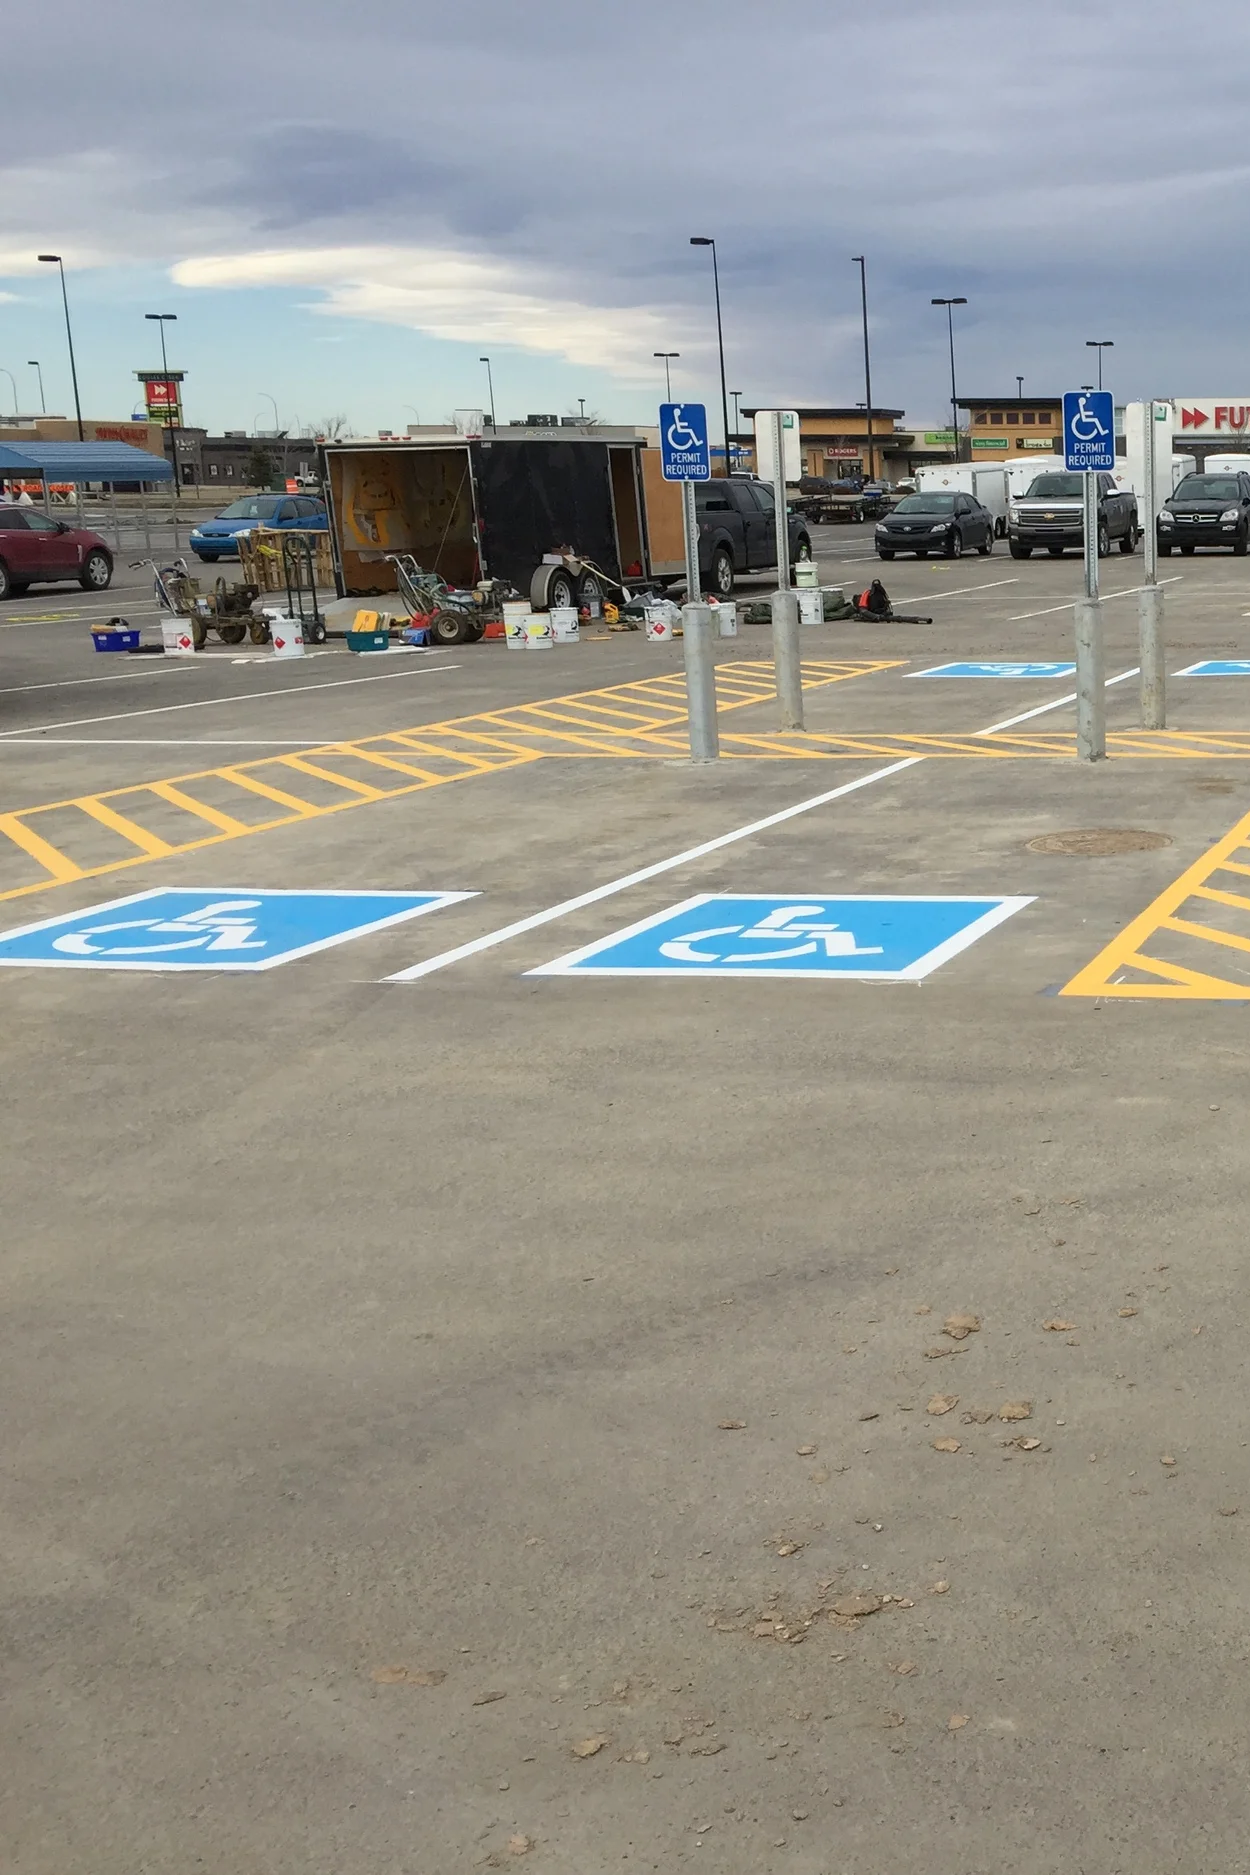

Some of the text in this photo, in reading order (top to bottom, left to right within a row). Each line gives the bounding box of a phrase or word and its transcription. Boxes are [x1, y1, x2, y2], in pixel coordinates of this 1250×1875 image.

[834, 446, 857, 455] ROGERS
[1074, 442, 1106, 454] PERMIT
[670, 452, 701, 463] PERMIT
[1068, 454, 1112, 466] REQUIRED
[665, 464, 707, 476] REQUIRED
